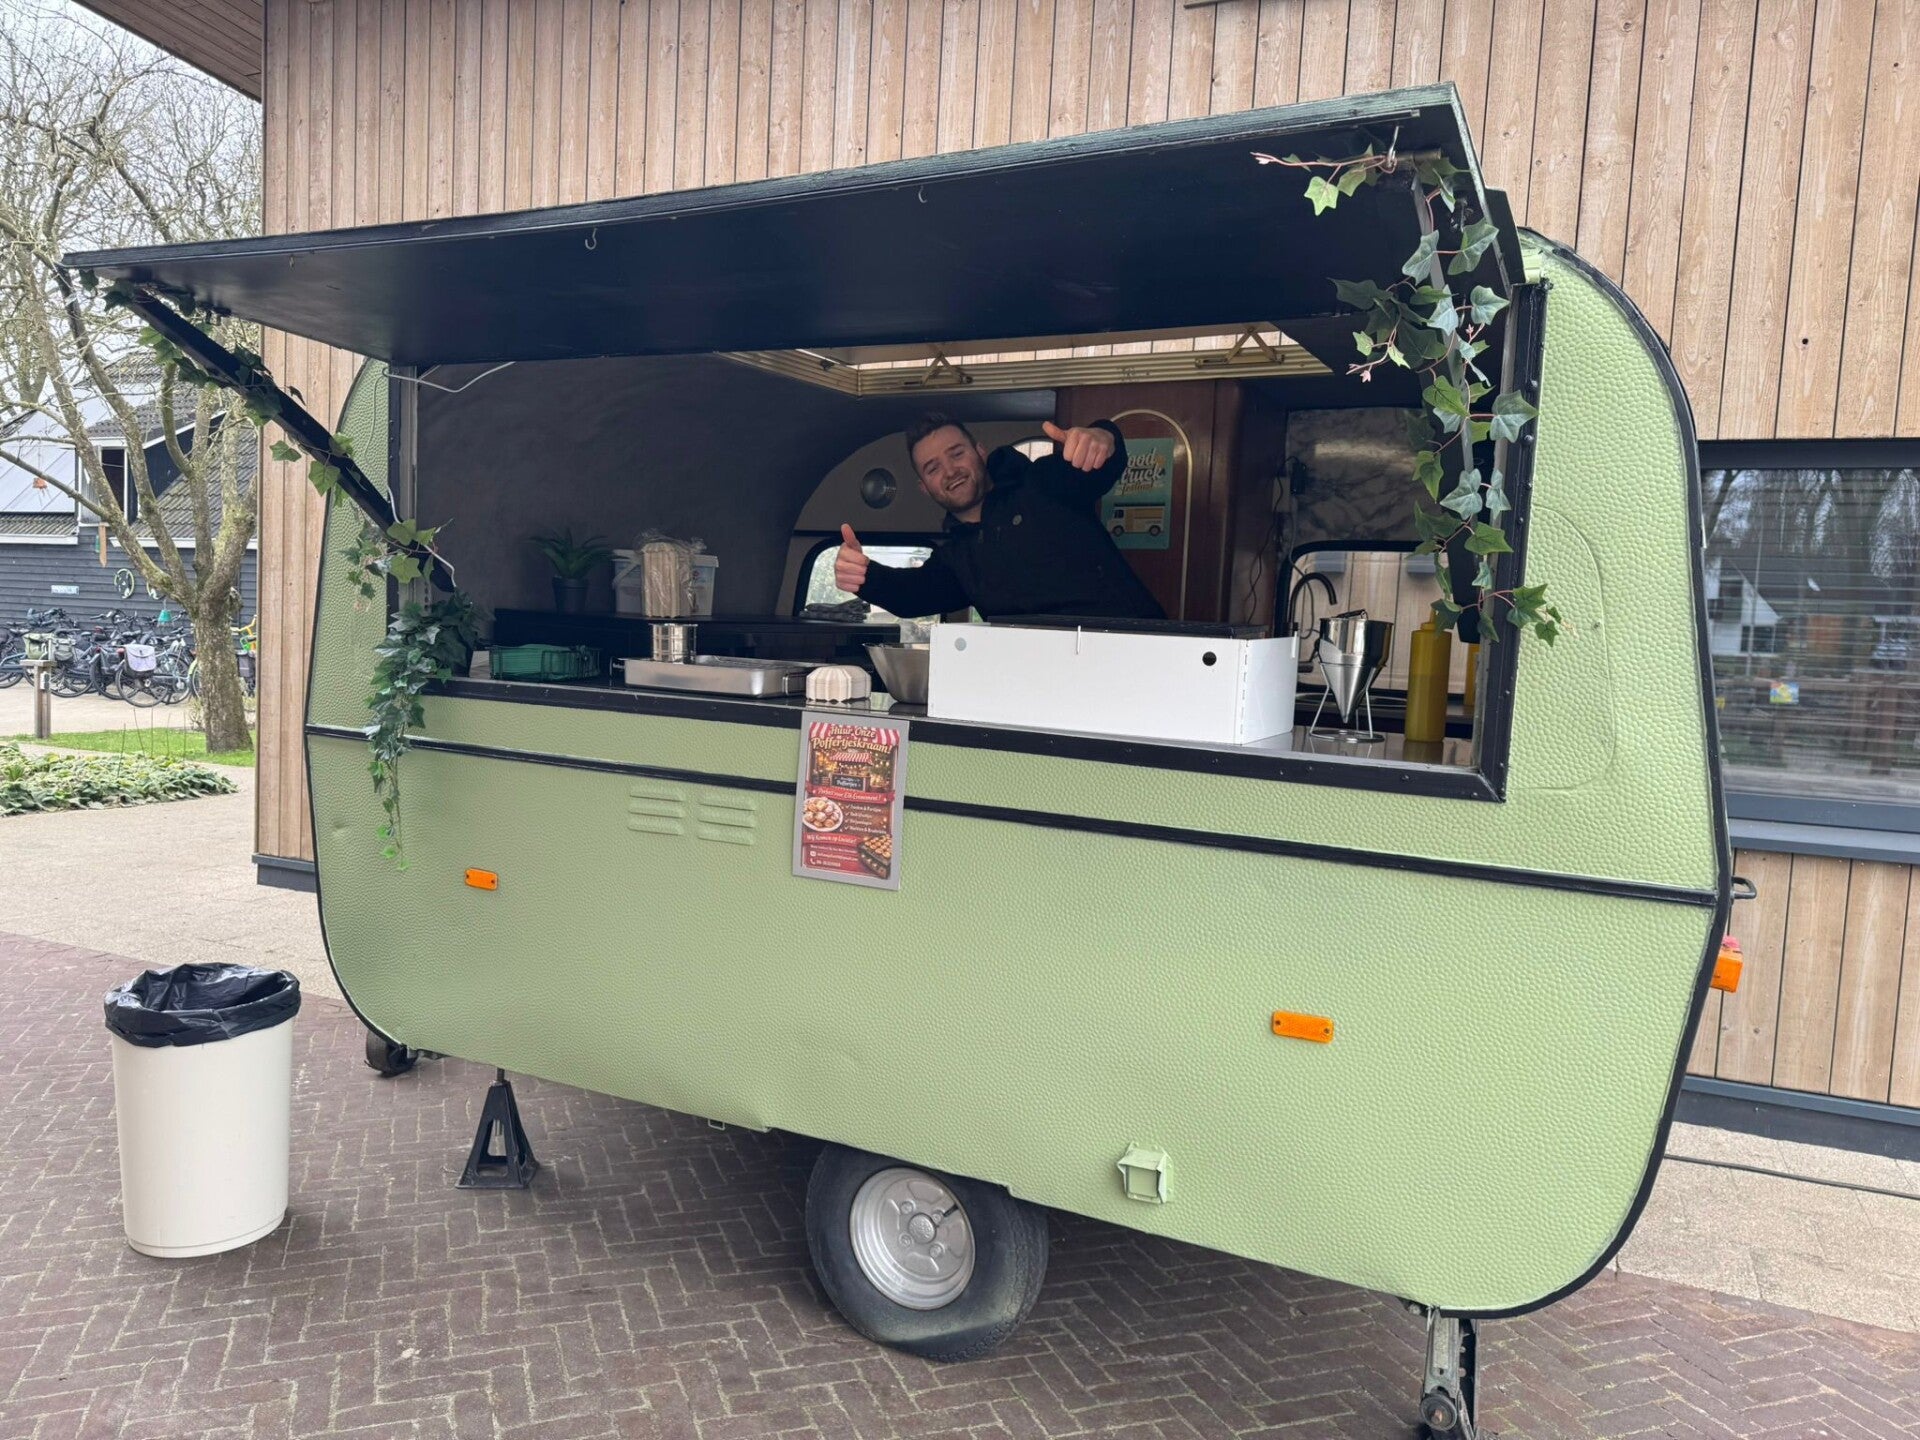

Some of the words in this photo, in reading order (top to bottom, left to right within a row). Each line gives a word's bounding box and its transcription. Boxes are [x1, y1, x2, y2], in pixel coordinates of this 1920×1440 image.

[1127, 448, 1157, 467] ood
[1121, 466, 1164, 483] truck
[829, 725, 853, 736] Huur
[855, 727, 877, 737] Onze
[811, 737, 892, 753] Poffertjeskraam!
